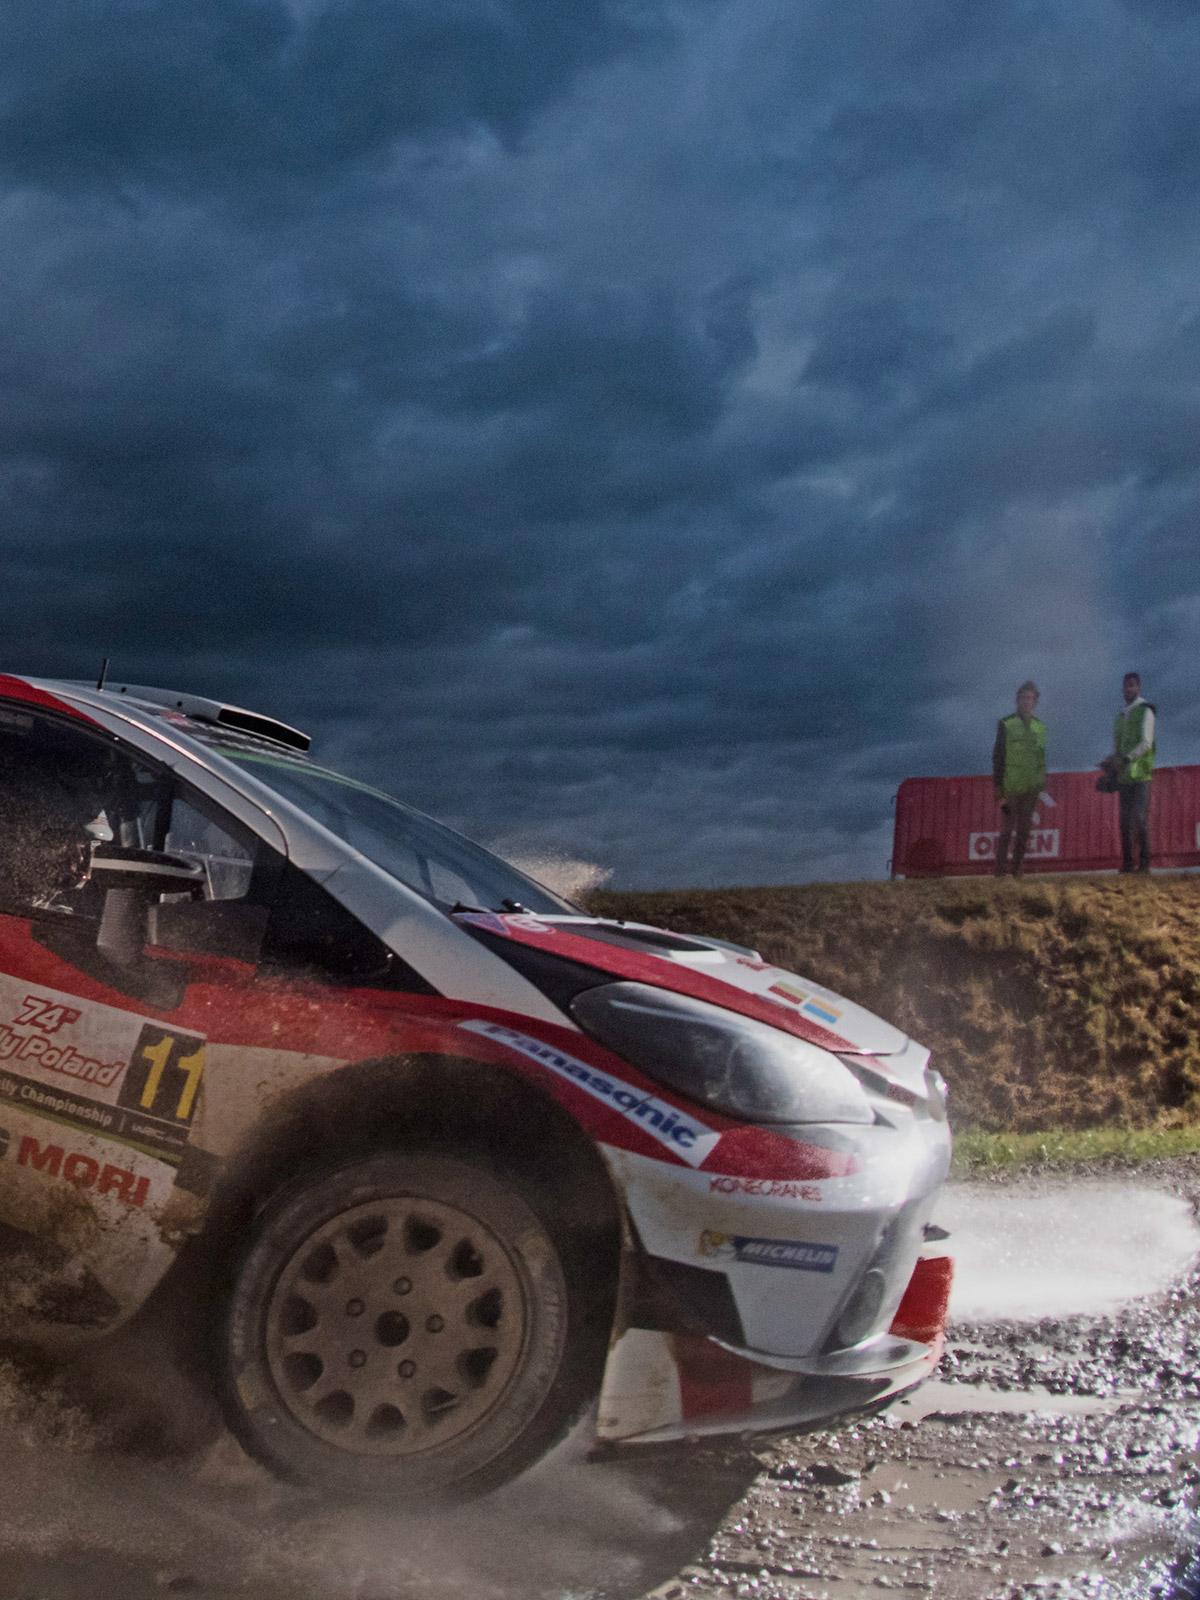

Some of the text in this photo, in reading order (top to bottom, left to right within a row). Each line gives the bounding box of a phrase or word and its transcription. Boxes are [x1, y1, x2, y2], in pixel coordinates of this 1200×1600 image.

[974, 834, 1054, 856] OEN
[16, 1035, 126, 1088] Poland
[141, 1036, 204, 1119] 11
[485, 1025, 698, 1148] Panasonic
[20, 1085, 112, 1127] Championship
[16, 1136, 151, 1208] MORI
[742, 1242, 836, 1264] MICHELIN
